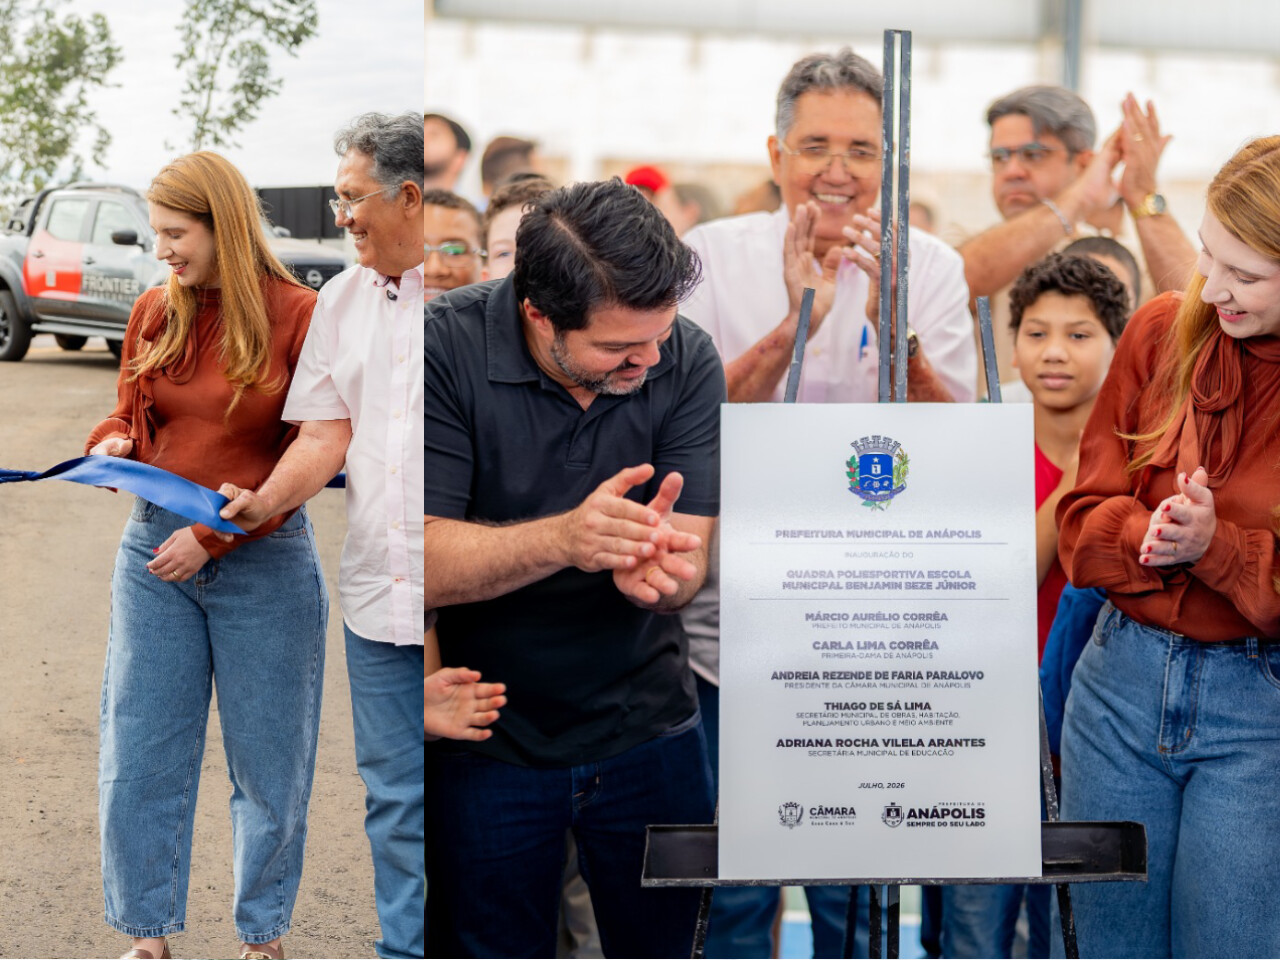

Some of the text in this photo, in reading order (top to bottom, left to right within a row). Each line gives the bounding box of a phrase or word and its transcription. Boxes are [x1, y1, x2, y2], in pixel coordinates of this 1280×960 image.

[82, 274, 140, 295] FRONTIER
[775, 528, 982, 538] PREFEITURA MUNICIPAL DE ANÁPOLIS
[786, 570, 972, 578] QUADRA POLIESPORTIVA ESCOLA
[782, 581, 843, 590] MUNICIPAL
[845, 581, 902, 590] BENJAMIN
[935, 580, 976, 590] JÚNIOR
[805, 611, 949, 621] MÁRCIO AURÉLIO CORRÊA
[812, 638, 940, 650] CARLA LIMA CORRÊA
[771, 671, 985, 680] ANDREIA REZENDE DE FARIA PARALOVO
[824, 700, 932, 710] THIAGO DE SÁ LIMA
[776, 739, 986, 747] ADRIANA ROCHA VILELA ARANTES
[809, 805, 856, 816] CÂMARA
[906, 806, 986, 819] ANÁPOLIS
